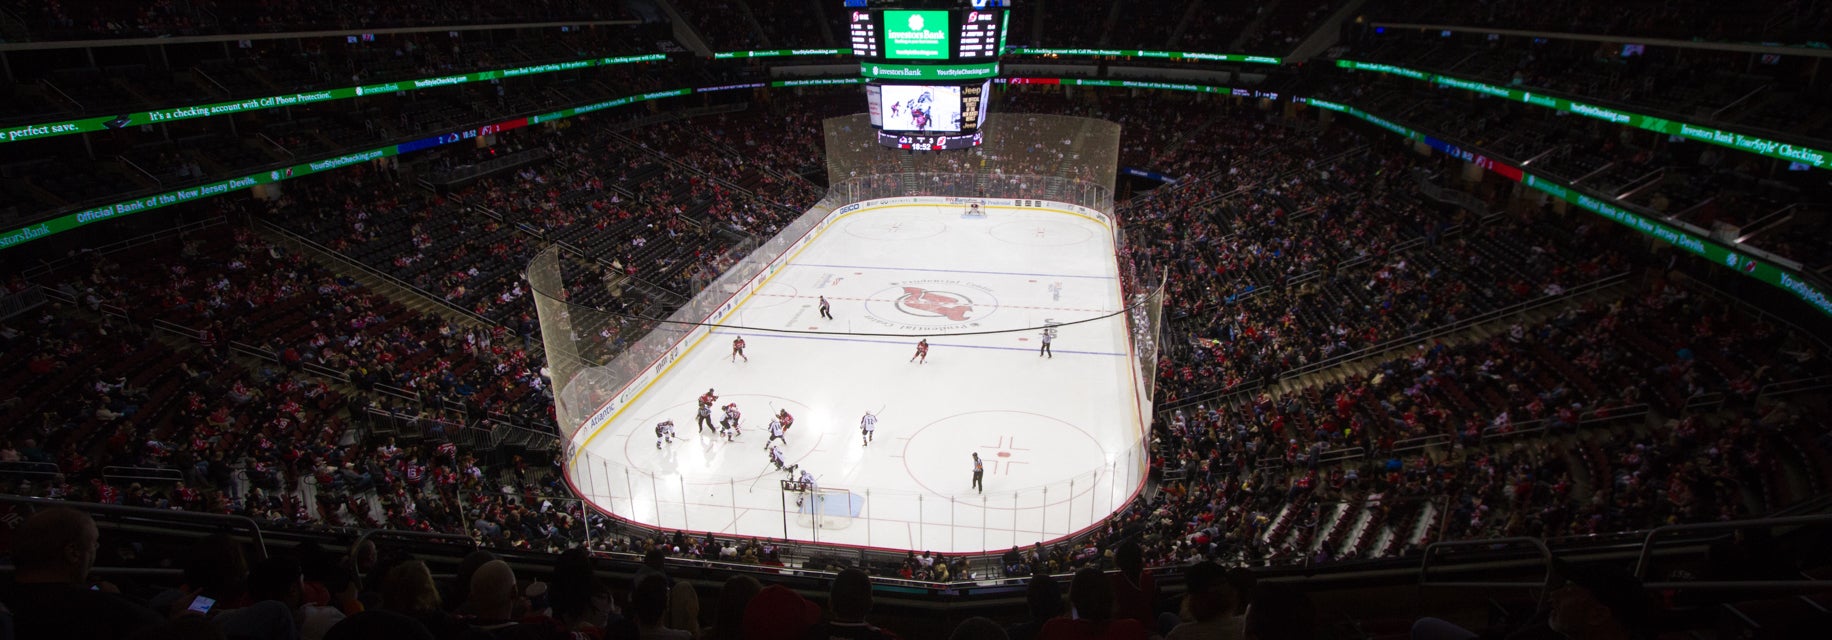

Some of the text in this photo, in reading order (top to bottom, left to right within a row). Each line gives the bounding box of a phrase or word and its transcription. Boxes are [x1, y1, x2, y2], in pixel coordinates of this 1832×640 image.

[879, 67, 922, 76] investorsBank
[936, 67, 990, 77] YourStyleChecking.com
[962, 86, 981, 95] Jeep
[149, 111, 164, 121] It's
[173, 106, 210, 118] checking
[211, 104, 241, 113] account
[242, 100, 259, 109] with
[260, 96, 274, 106] Cell
[275, 94, 296, 105] Phone
[9, 125, 49, 141] perfect
[51, 123, 78, 132] save.
[1681, 123, 1714, 140] Investors
[1713, 130, 1734, 144] Bank
[309, 150, 383, 170] YourStyleChecking.com
[77, 207, 113, 222] Official
[116, 201, 144, 214] Bank
[146, 197, 157, 206] of
[159, 193, 176, 204] the
[177, 190, 198, 200] New
[200, 184, 228, 196] Jersey
[840, 204, 859, 215] GEICO
[1654, 225, 1678, 243] Jersey
[590, 403, 615, 429] Atlantic
